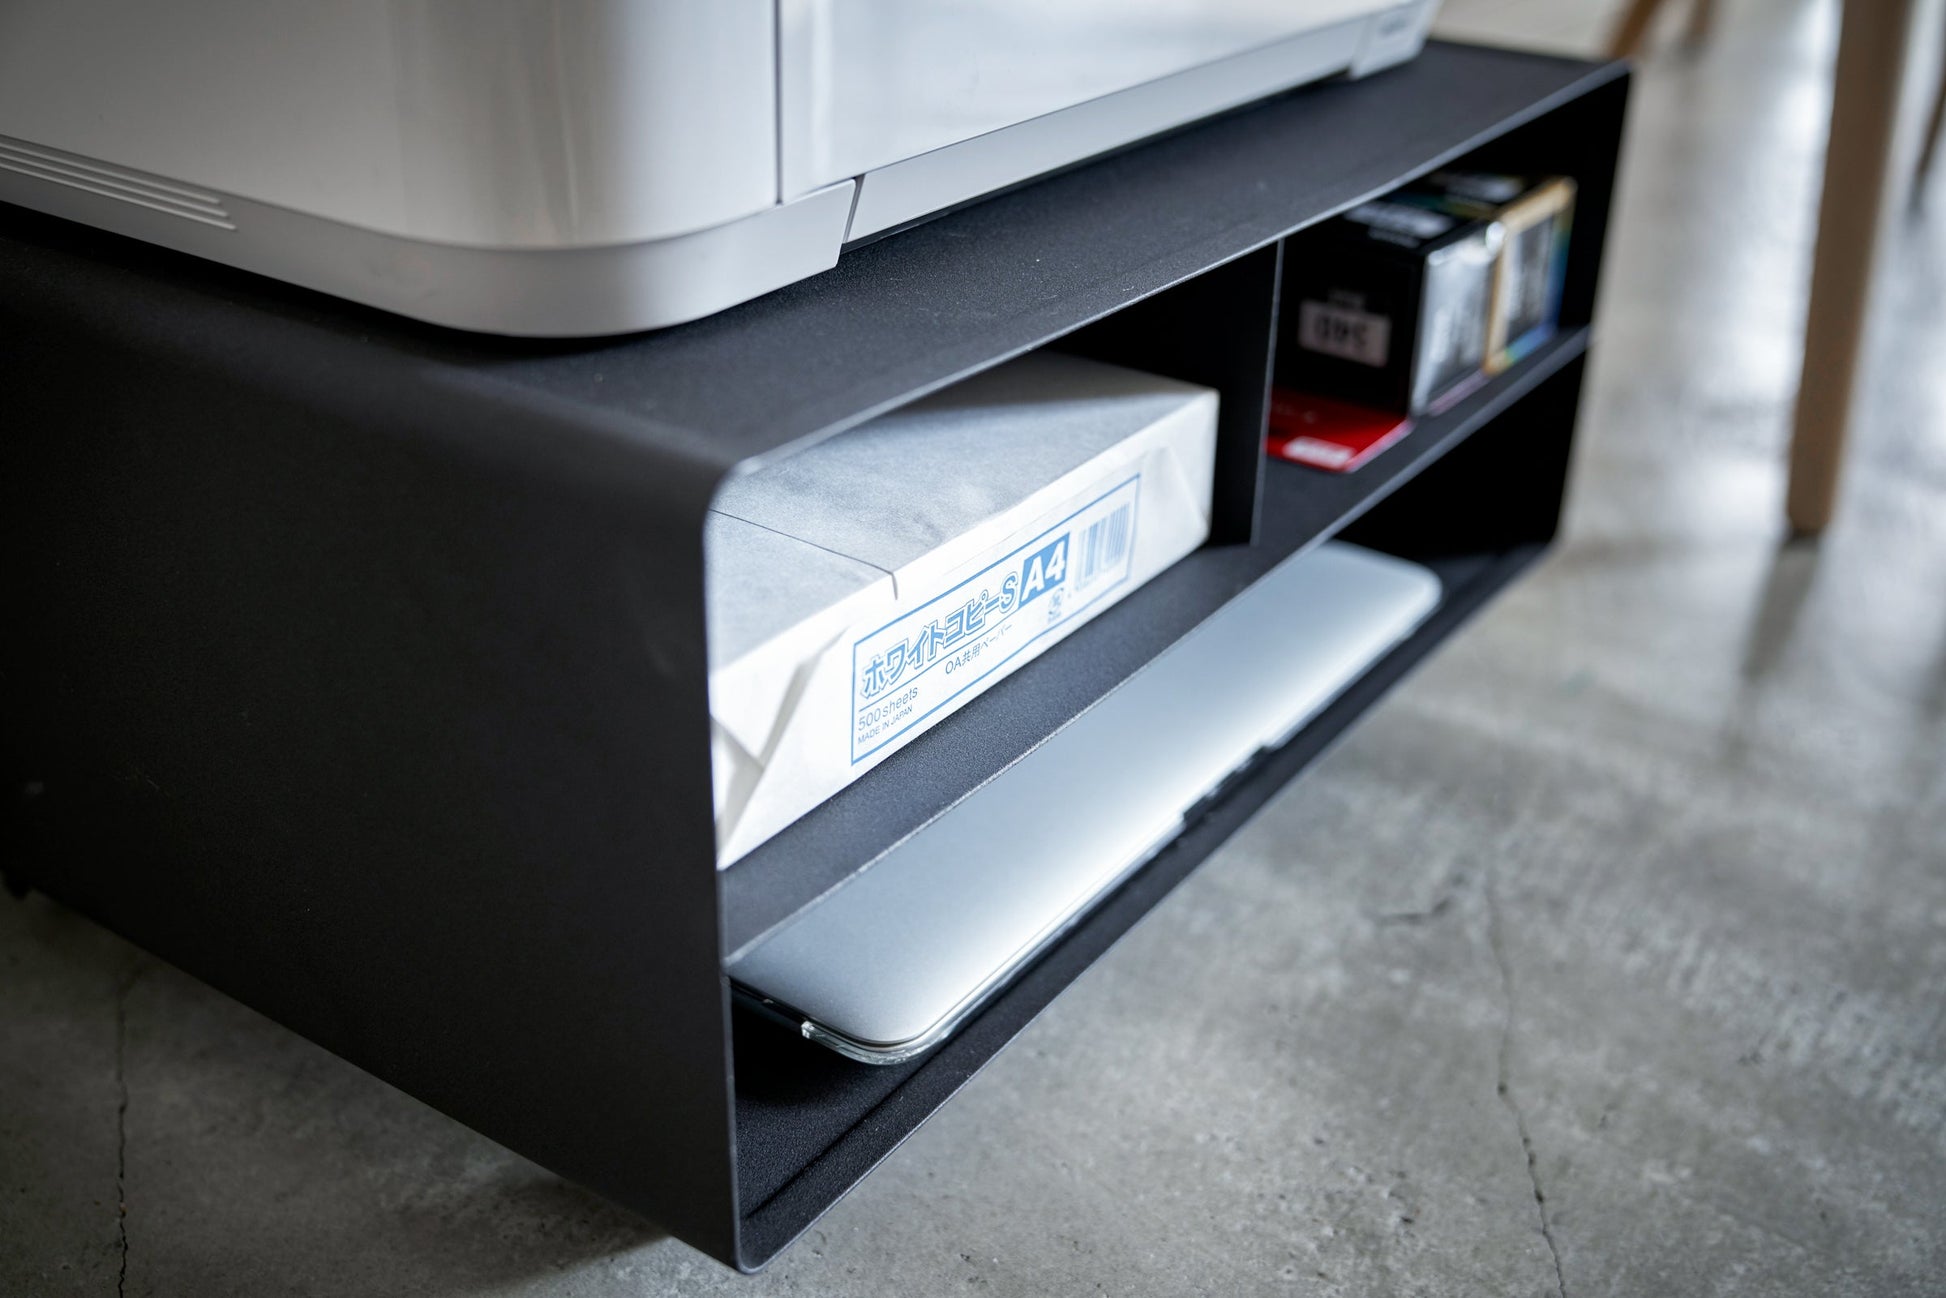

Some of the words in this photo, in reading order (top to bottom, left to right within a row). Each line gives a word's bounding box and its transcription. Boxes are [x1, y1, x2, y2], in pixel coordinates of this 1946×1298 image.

[1020, 539, 1066, 603] A4
[858, 725, 880, 744] MADE
[882, 719, 890, 730] IN
[890, 704, 913, 725] JAPAN
